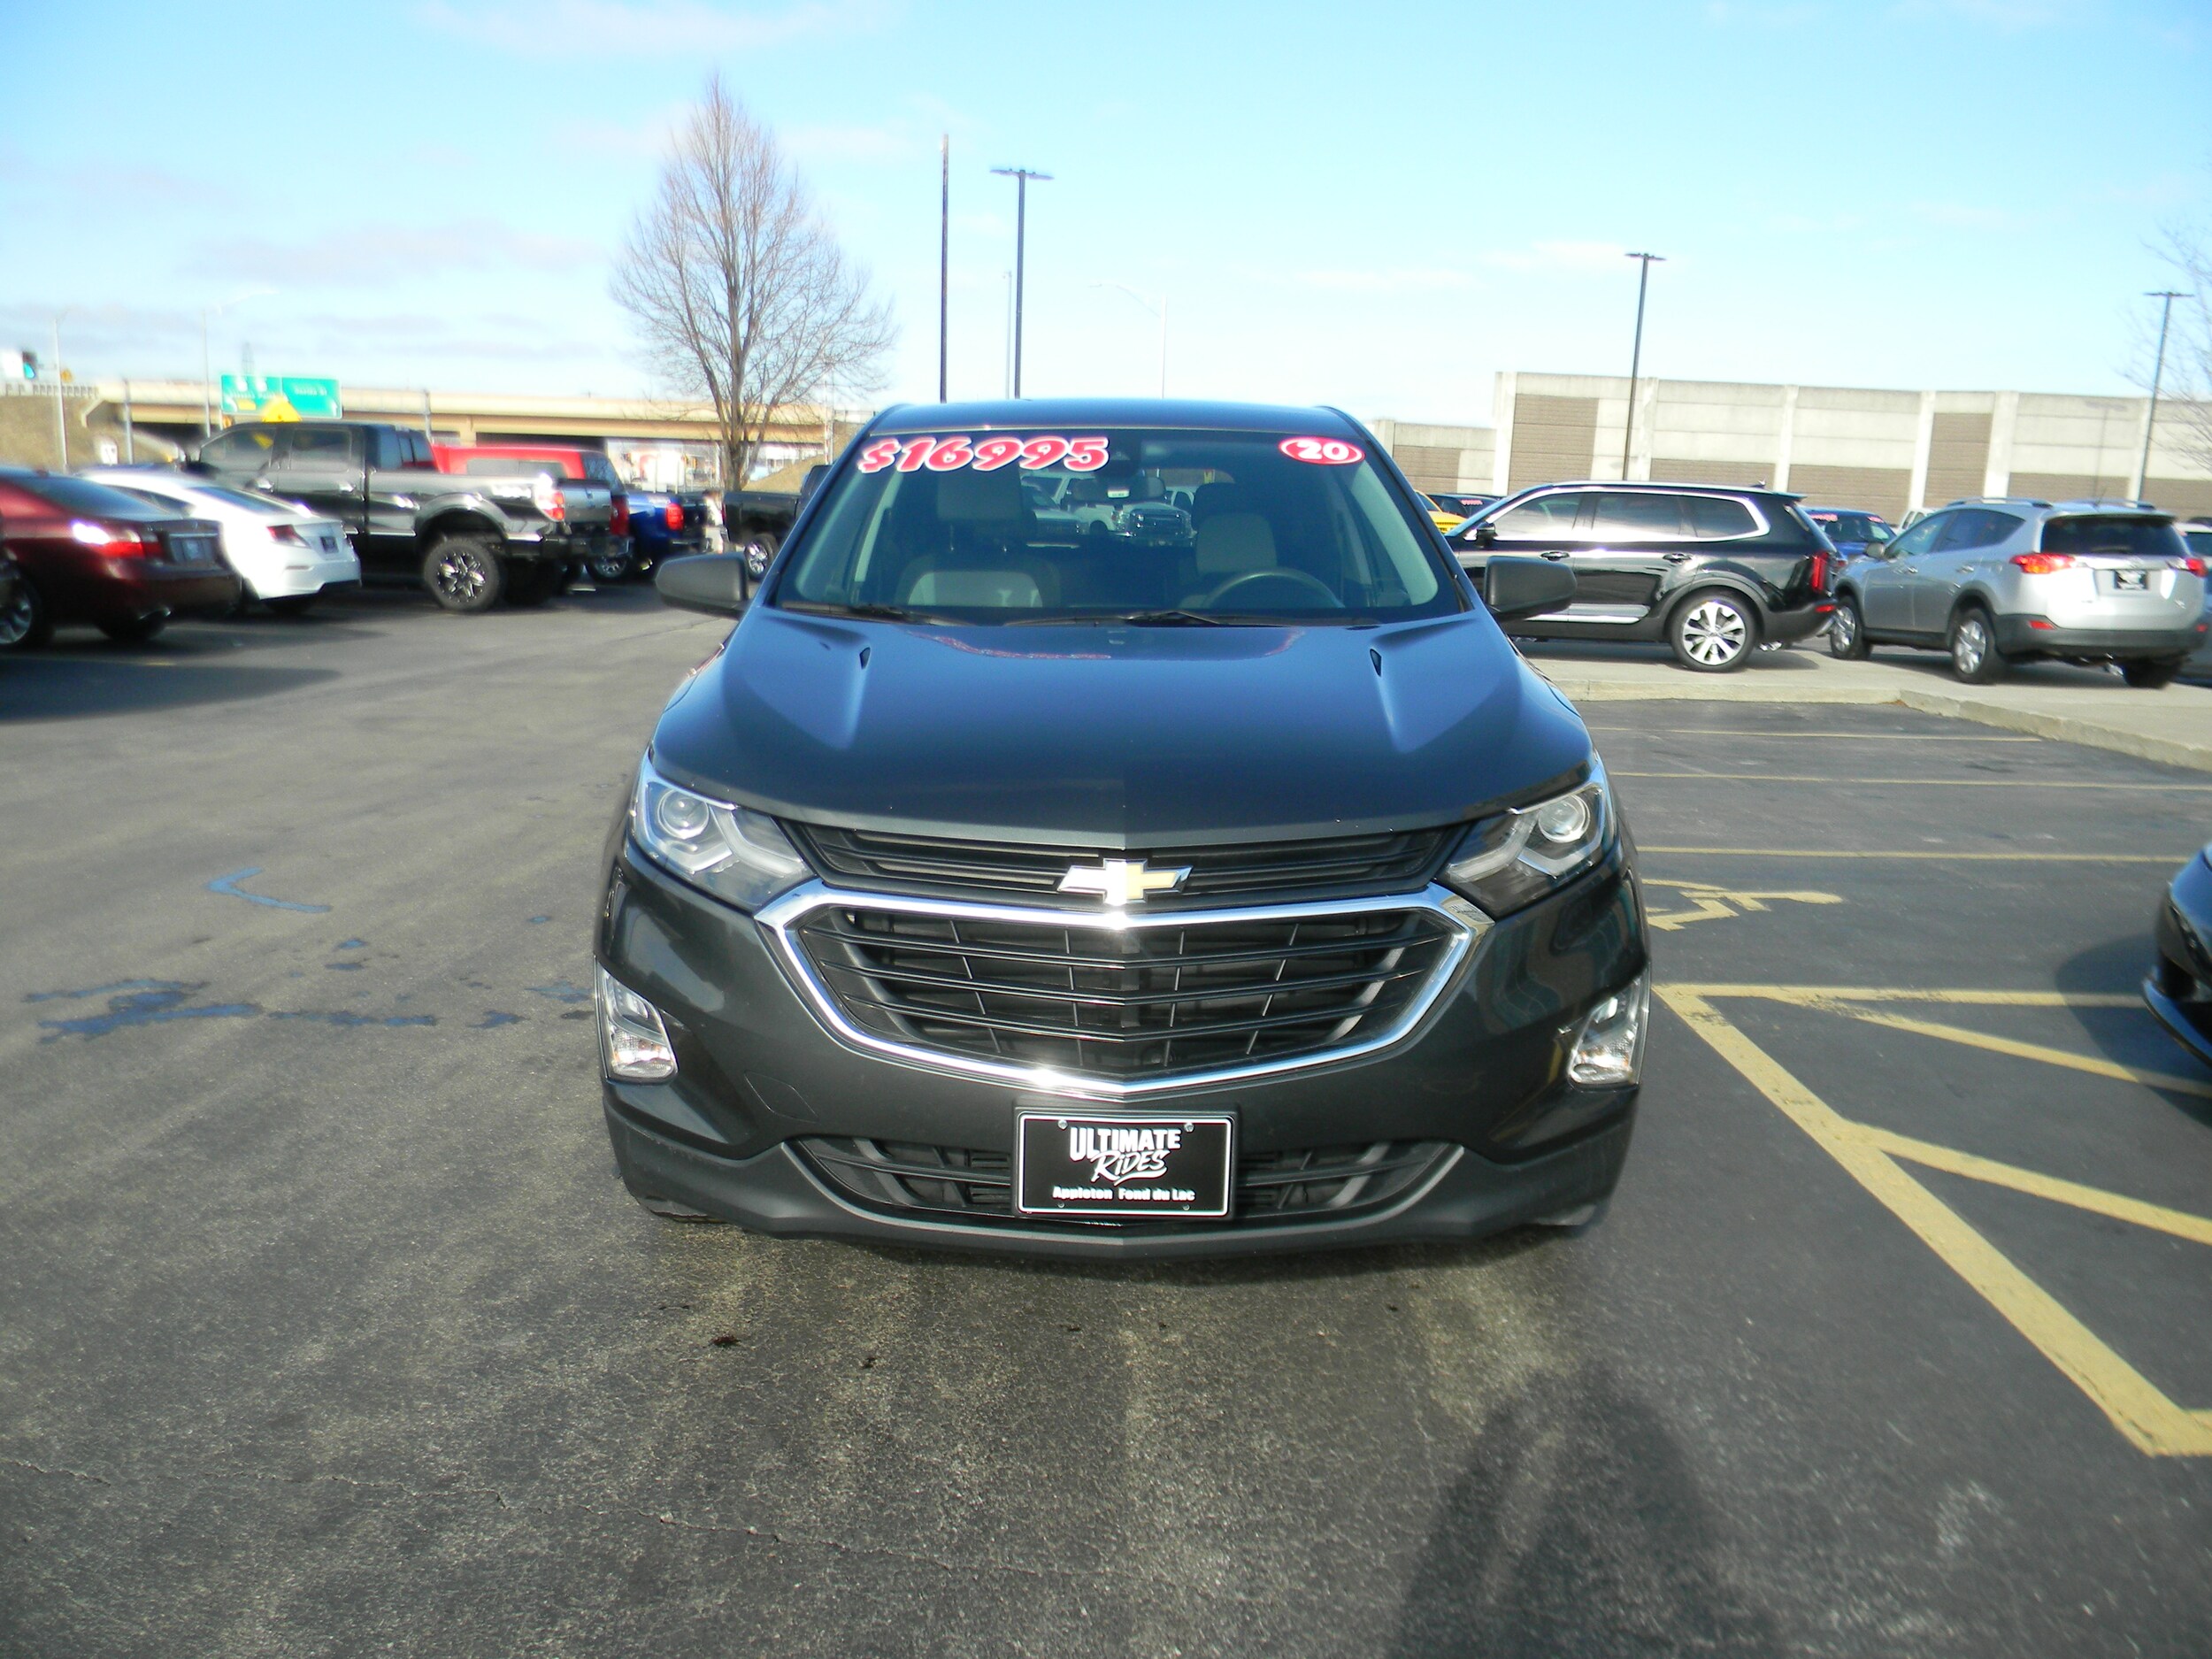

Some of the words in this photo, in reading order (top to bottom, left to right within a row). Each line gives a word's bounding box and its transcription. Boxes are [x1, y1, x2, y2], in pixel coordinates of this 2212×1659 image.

[857, 437, 1110, 473] $16995
[1296, 439, 1349, 461] 20
[1069, 1126, 1182, 1162] ULTIMATE
[1052, 1186, 1113, 1201] Appleton
[1118, 1187, 1151, 1201] Fond
[1152, 1187, 1171, 1201] du
[1171, 1188, 1196, 1202] Lac
